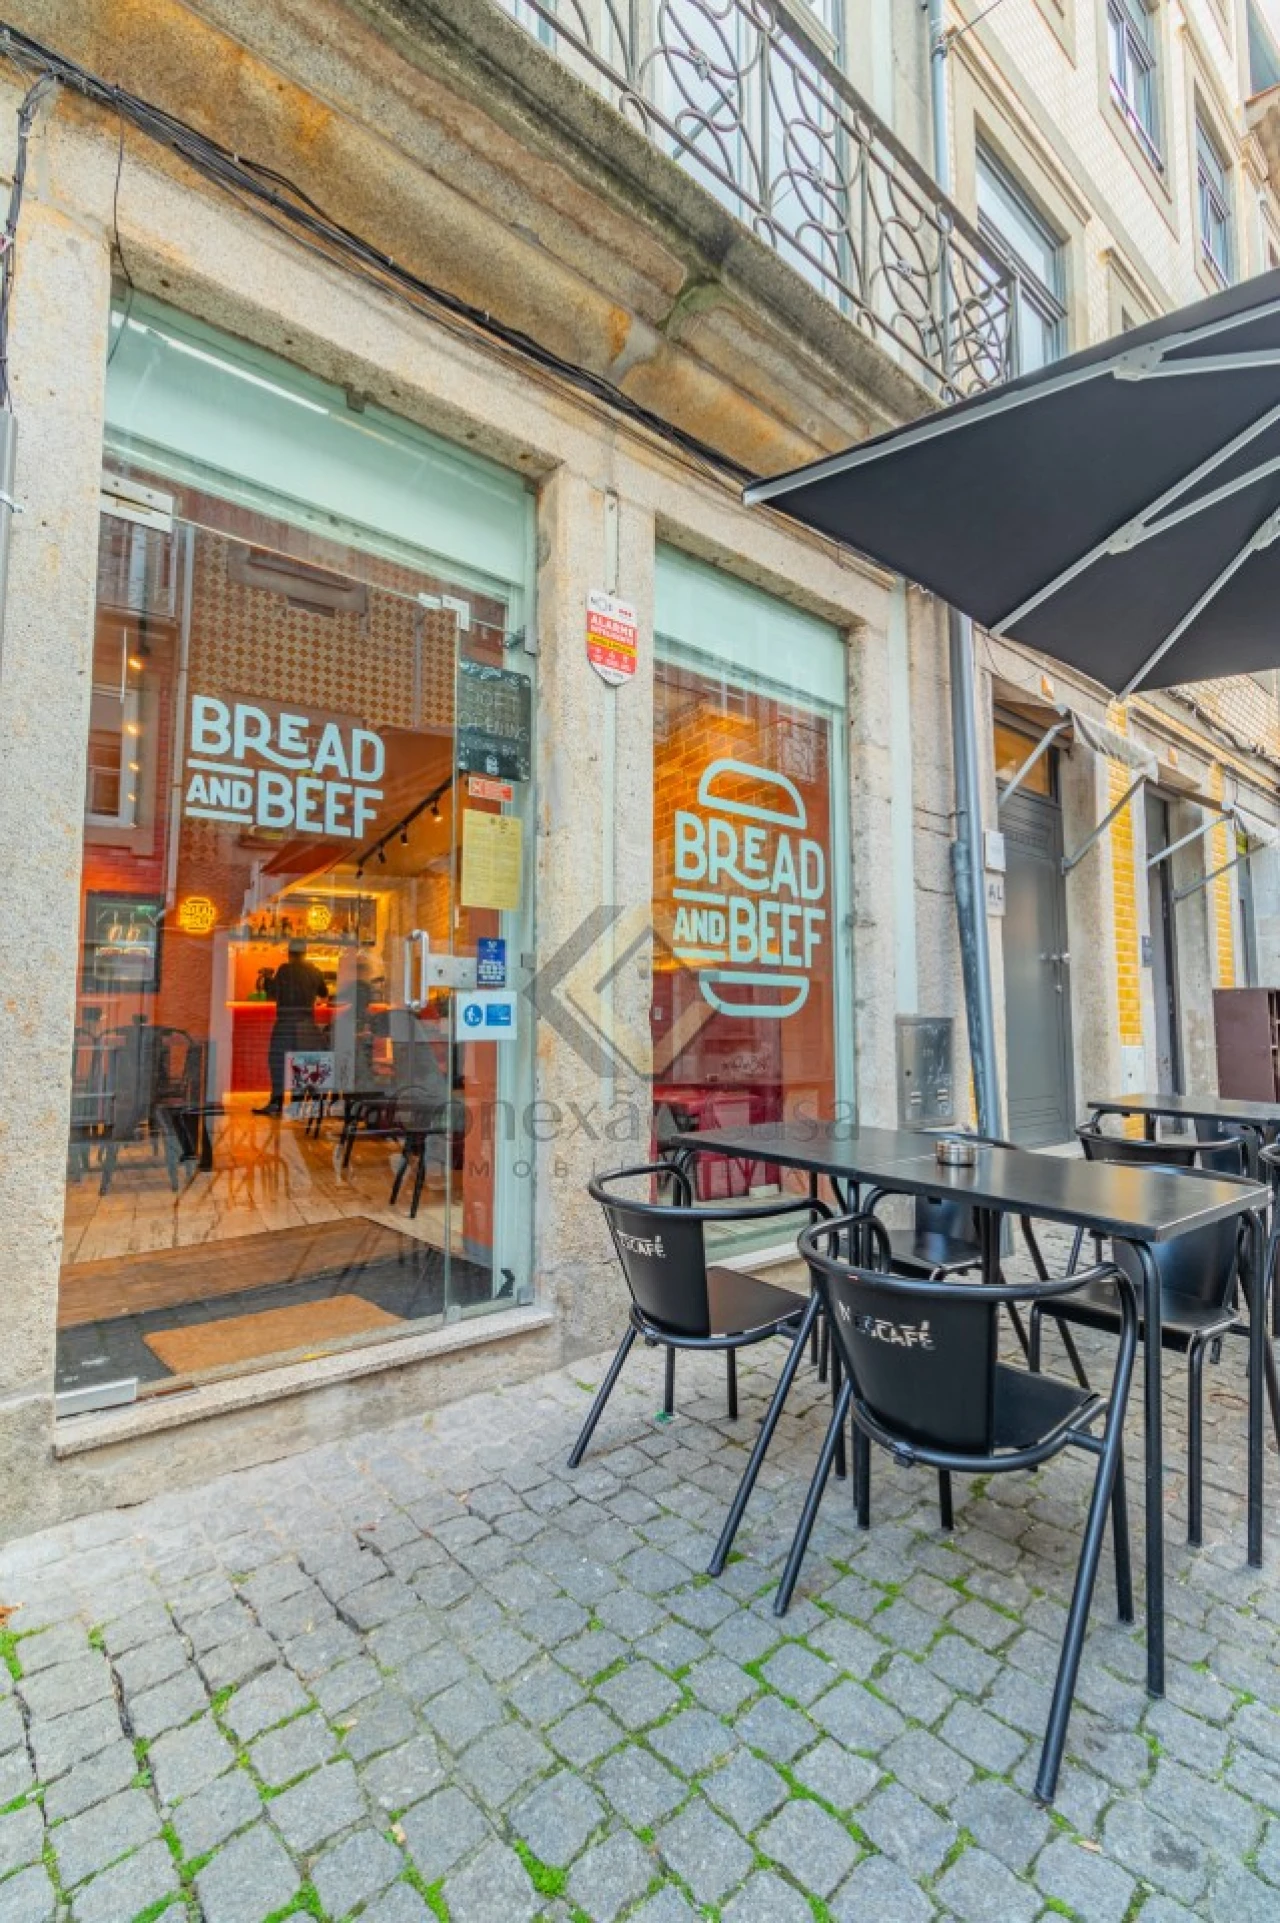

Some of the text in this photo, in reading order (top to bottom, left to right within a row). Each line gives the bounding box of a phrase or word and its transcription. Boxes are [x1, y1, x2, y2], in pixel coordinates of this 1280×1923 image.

[191, 694, 385, 782] BREAD
[186, 770, 384, 840] AND BEEF
[674, 810, 826, 900] BREAD
[672, 896, 826, 968] AND BEEF
